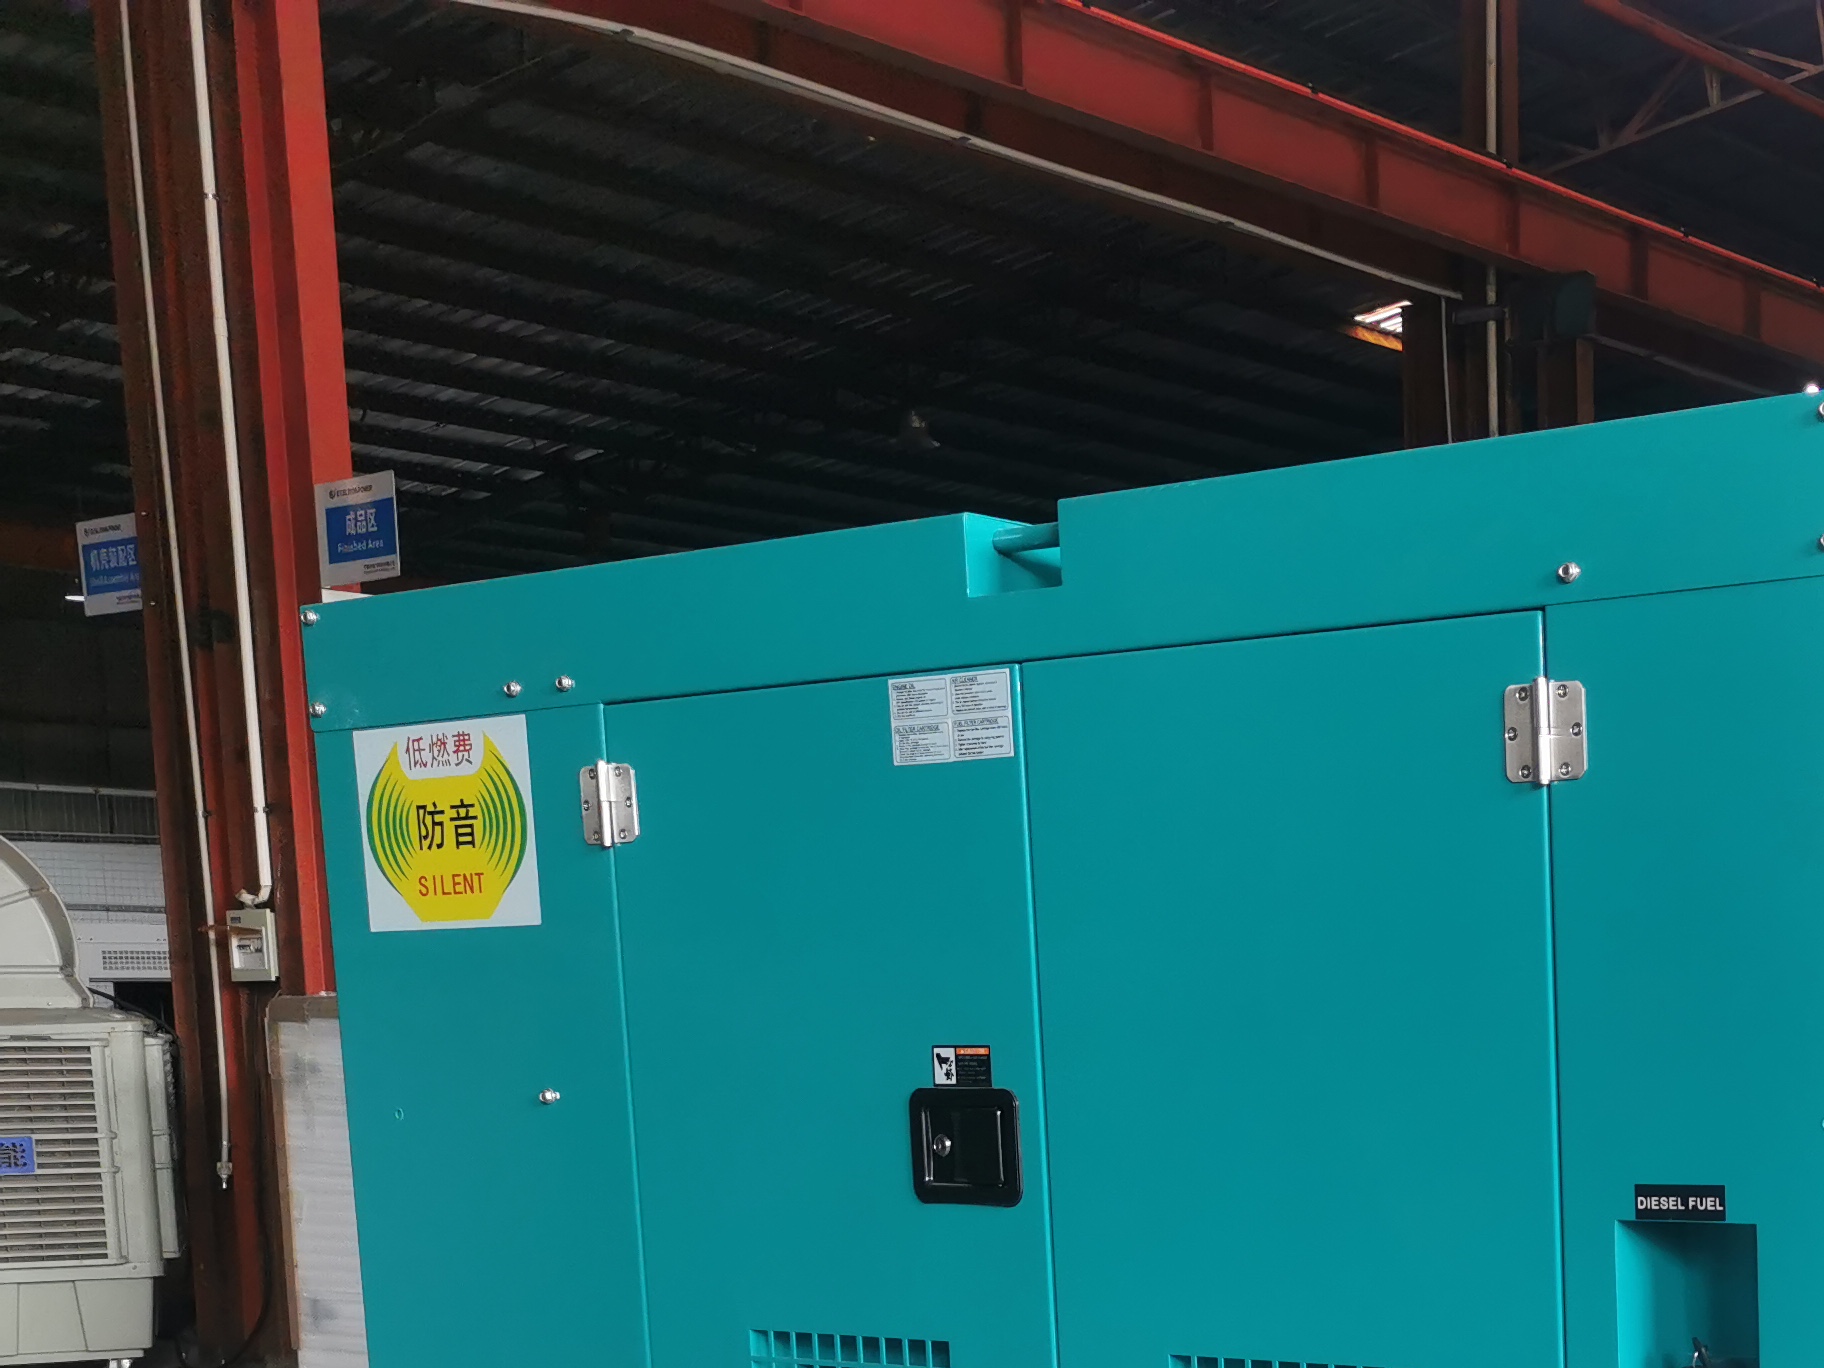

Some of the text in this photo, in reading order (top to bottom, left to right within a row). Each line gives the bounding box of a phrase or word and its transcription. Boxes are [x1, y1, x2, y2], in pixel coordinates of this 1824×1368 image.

[345, 508, 378, 536] 成品区
[368, 539, 384, 549] Area
[405, 731, 473, 770] 低燃费
[415, 798, 478, 850] 防音
[418, 872, 485, 897] SILENT
[1637, 1197, 1724, 1211] DIESEL FUEL
